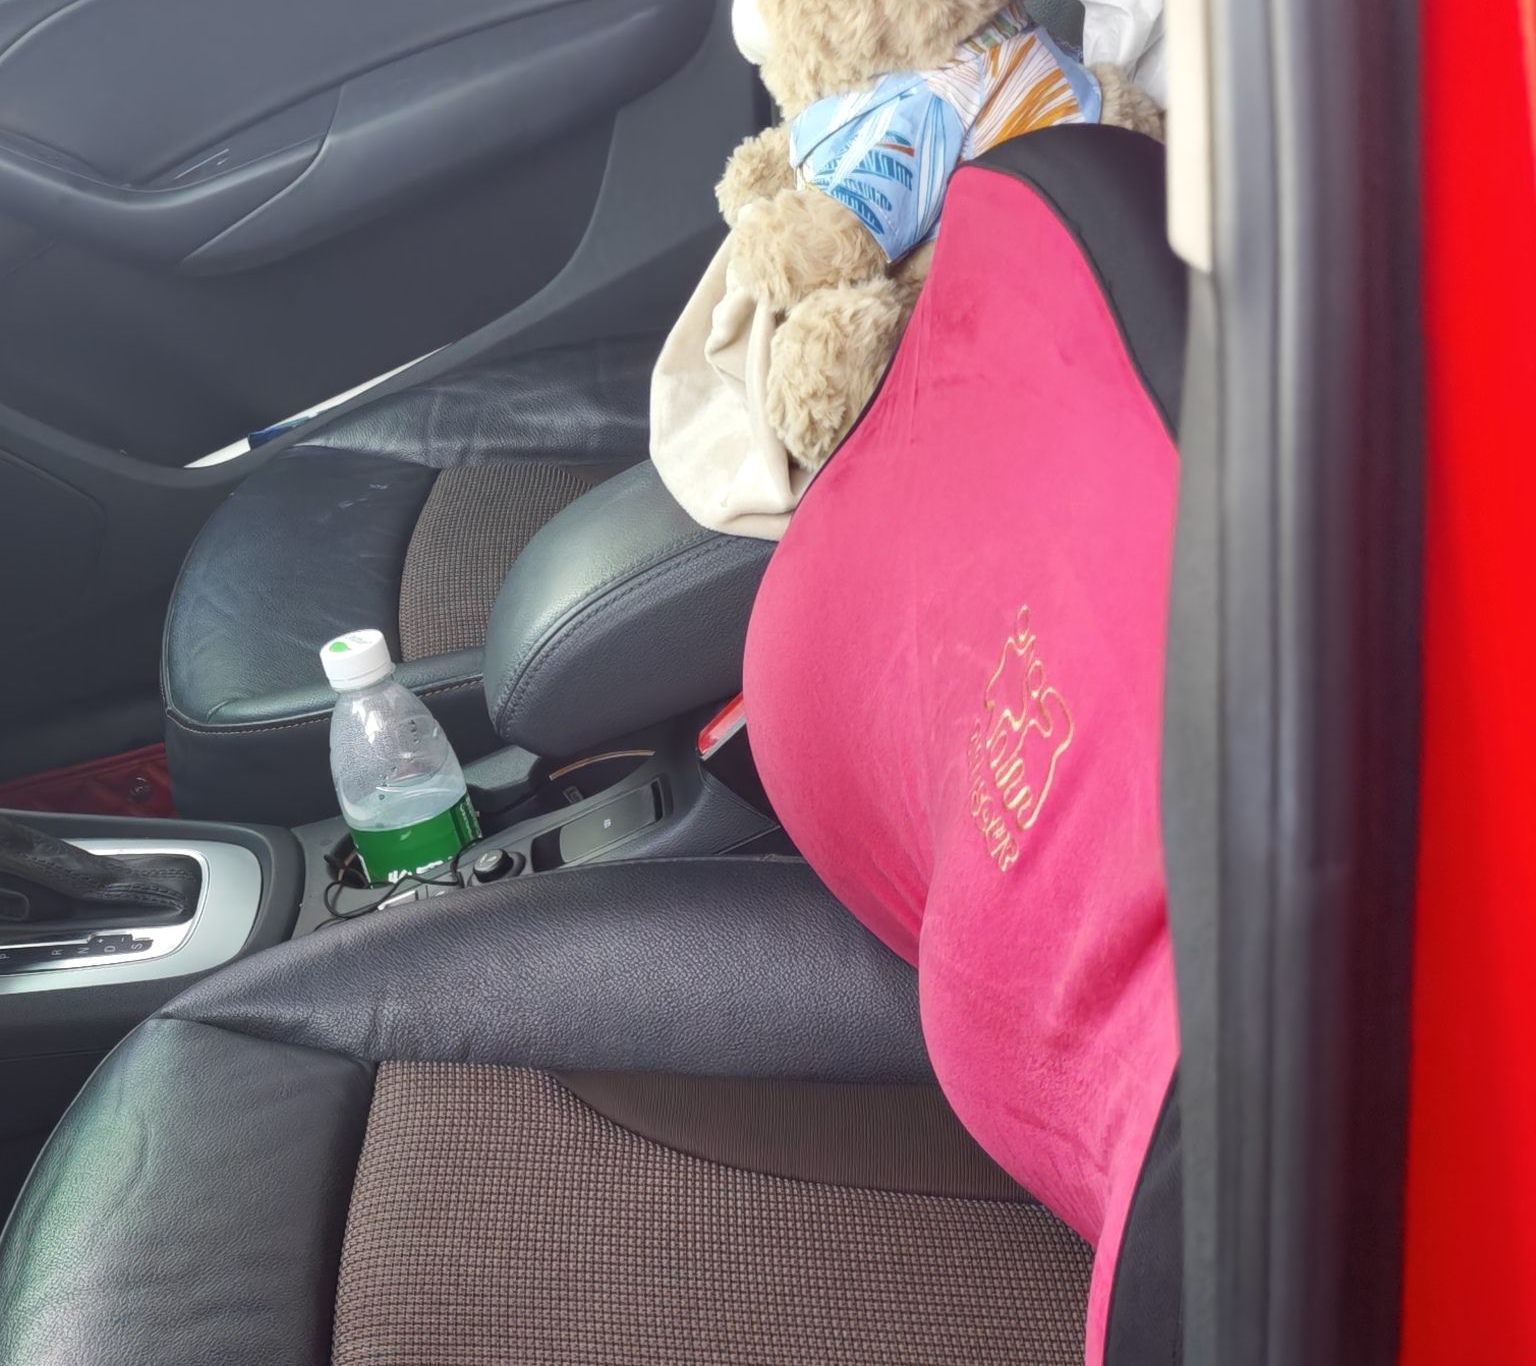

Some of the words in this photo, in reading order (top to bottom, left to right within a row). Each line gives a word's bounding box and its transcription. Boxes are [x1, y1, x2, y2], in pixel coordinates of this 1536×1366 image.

[0, 953, 11, 961] P
[52, 948, 64, 956] R
[104, 945, 116, 953] D
[131, 942, 144, 951] S
